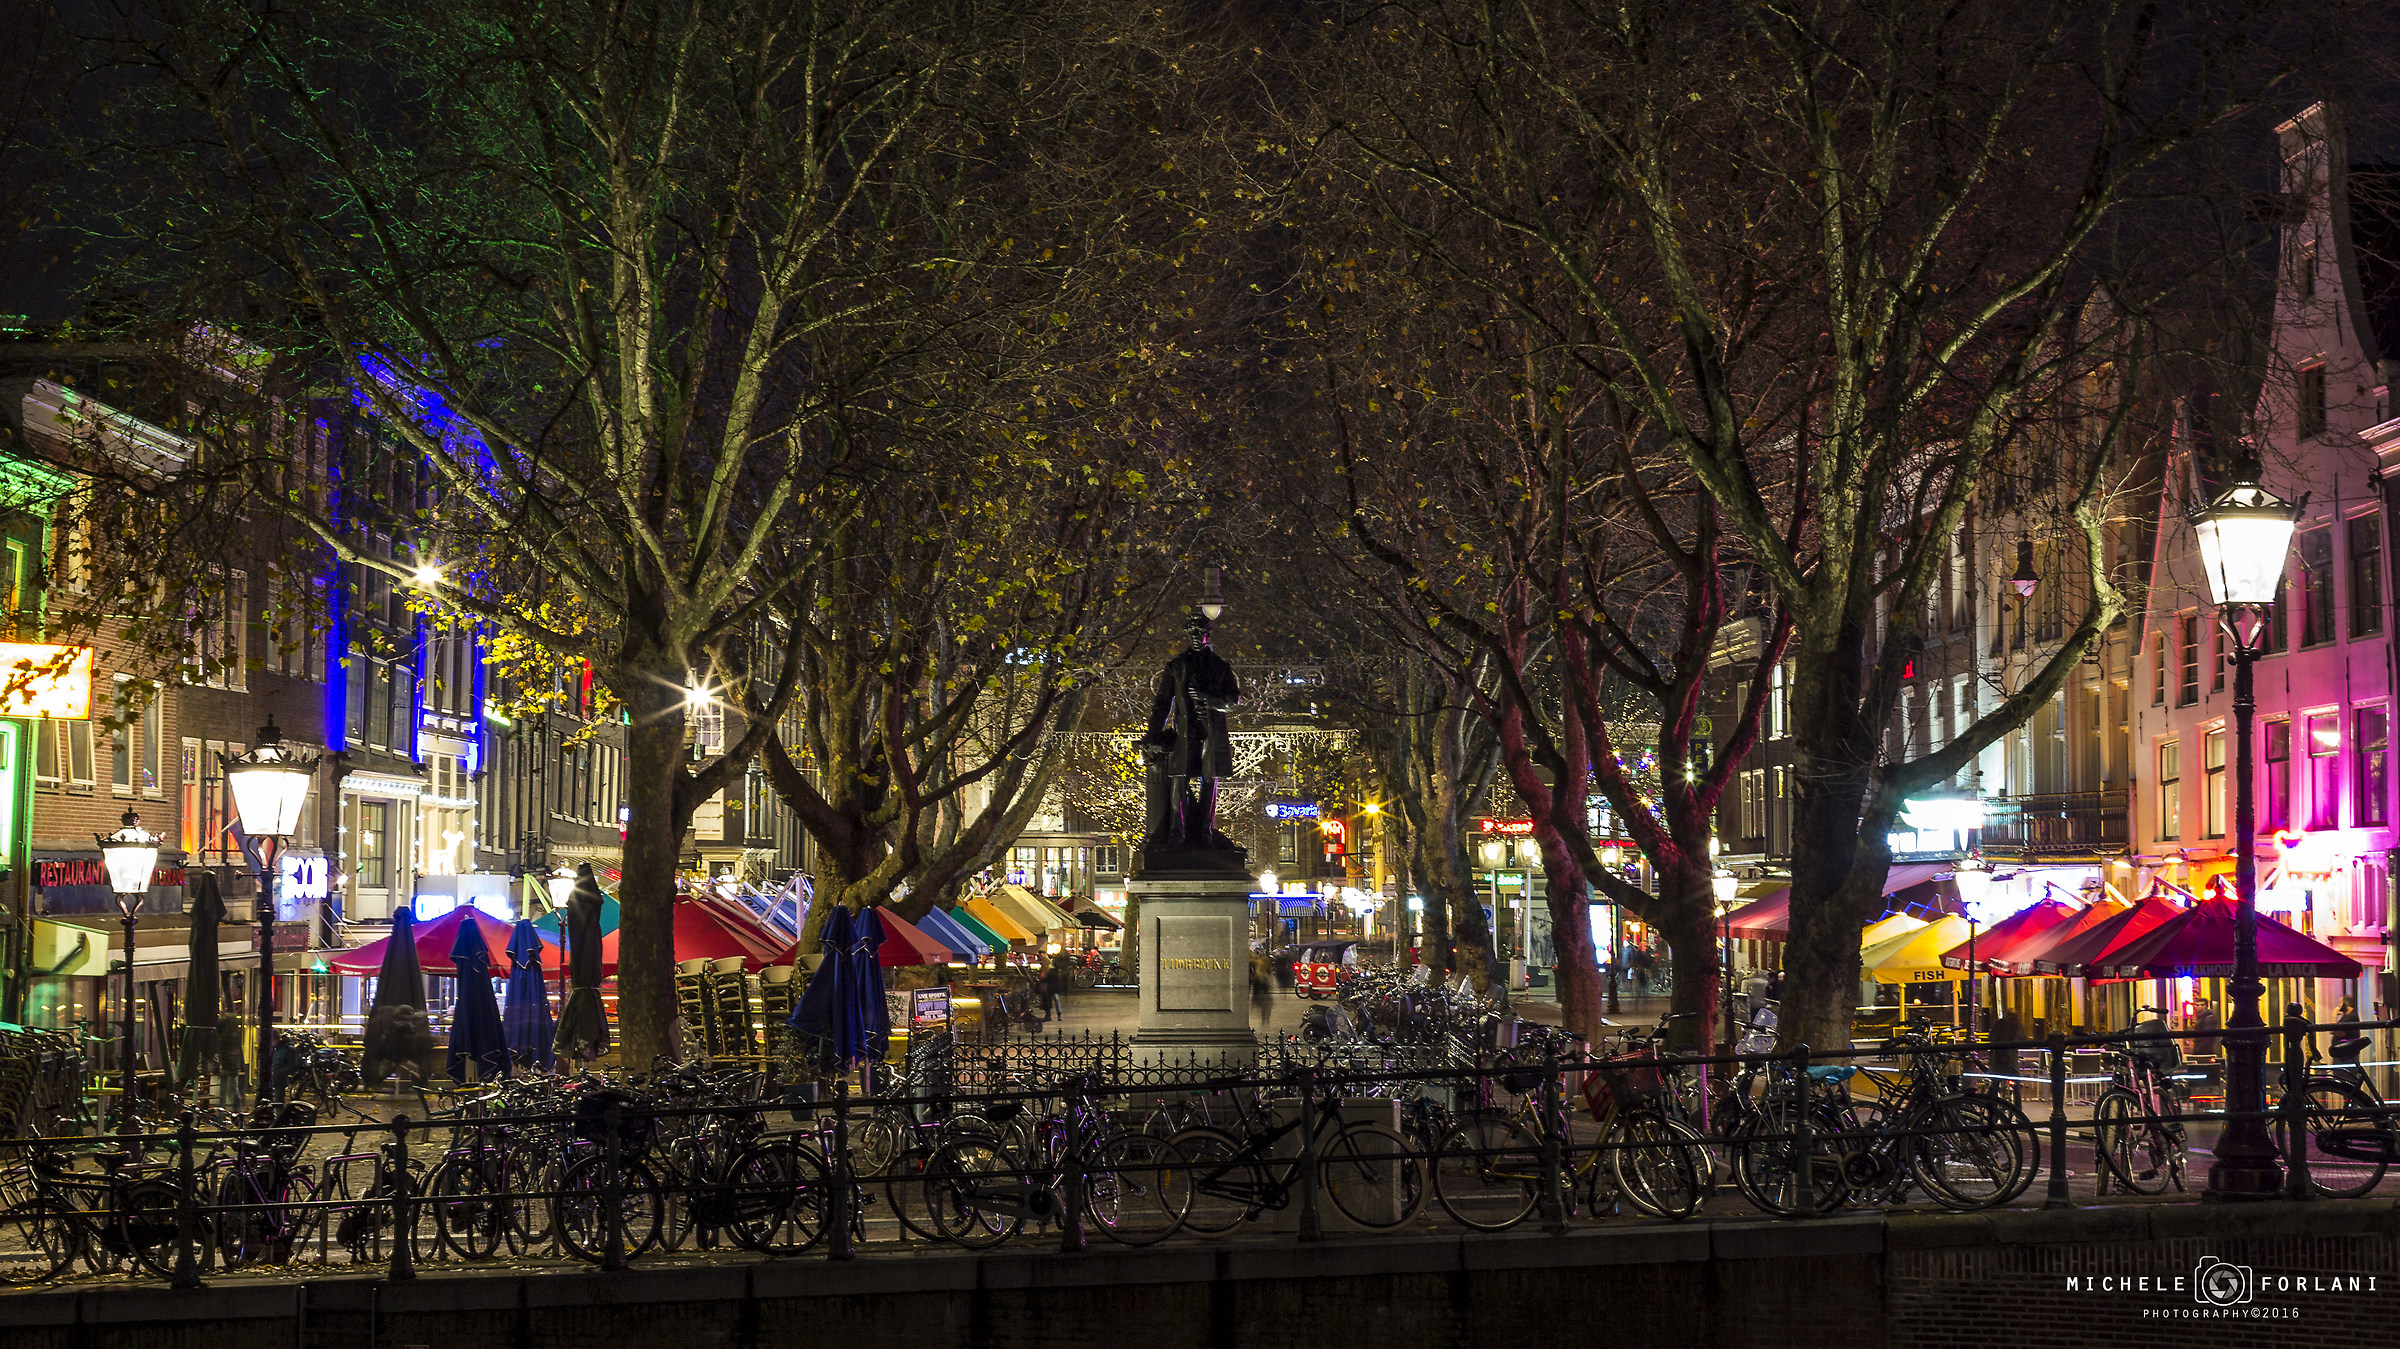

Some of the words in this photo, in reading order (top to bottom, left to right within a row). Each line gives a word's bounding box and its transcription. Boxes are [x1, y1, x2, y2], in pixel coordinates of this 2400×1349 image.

[40, 861, 105, 887] RESTAURANT
[1160, 958, 1231, 970] THORBECKE
[2174, 963, 2235, 977] STEAKHOUS
[2267, 963, 2284, 977] LA
[2285, 963, 2318, 977] VACA
[1914, 970, 1945, 981] FISH
